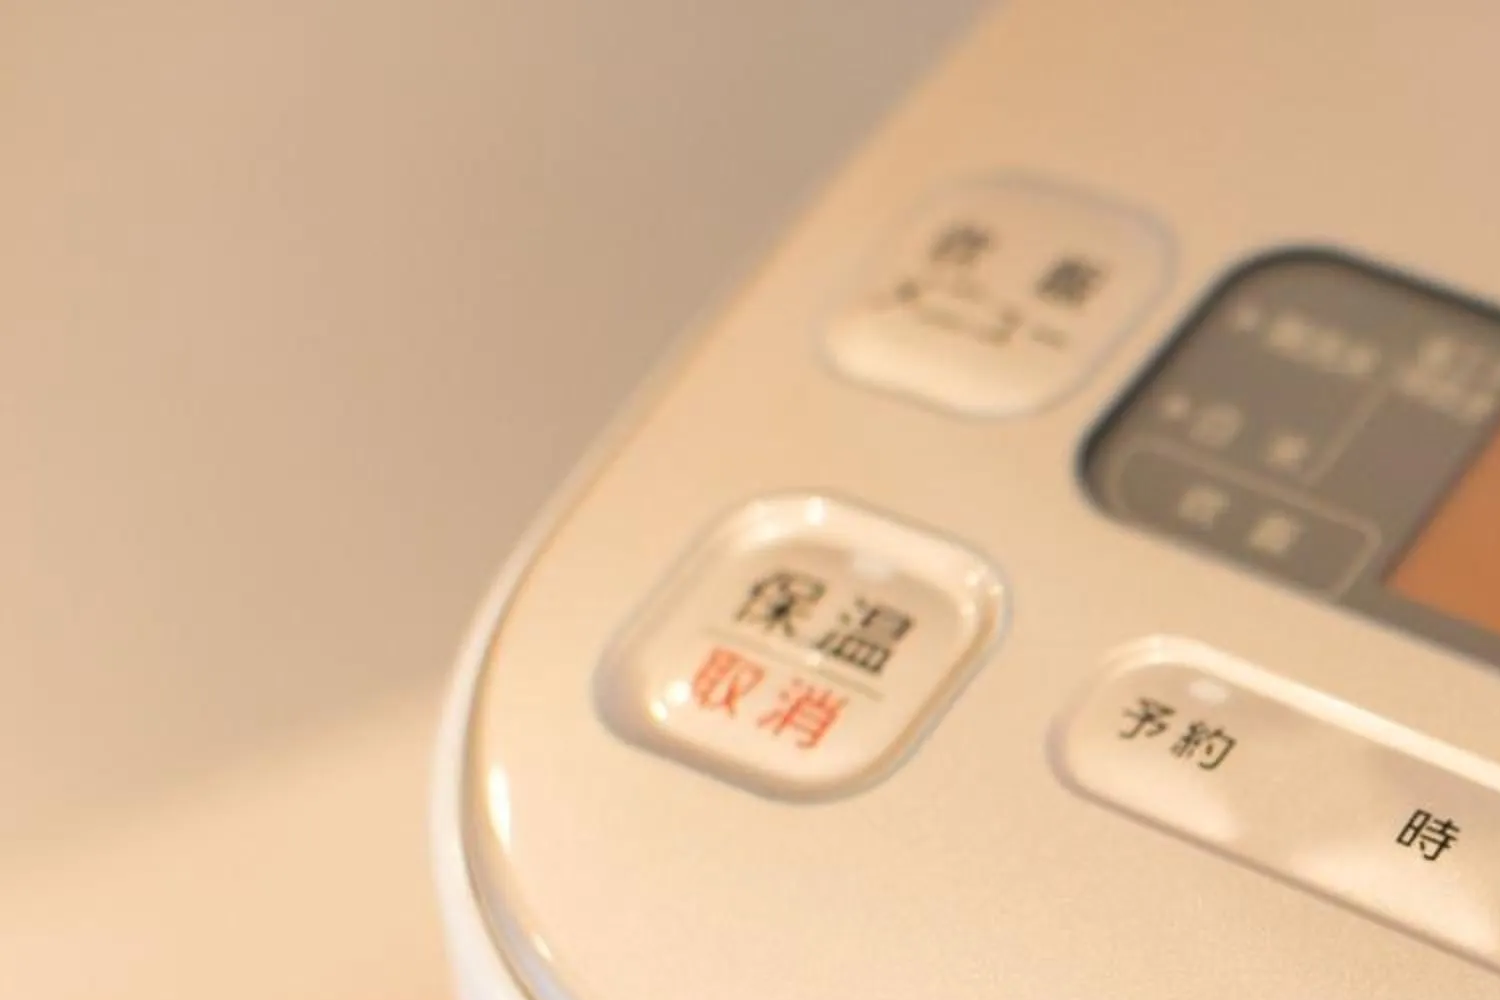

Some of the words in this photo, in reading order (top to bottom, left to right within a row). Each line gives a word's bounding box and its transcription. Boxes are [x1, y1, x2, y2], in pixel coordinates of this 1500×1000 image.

[735, 569, 916, 677] 保温
[692, 646, 849, 749] 取消
[1117, 697, 1237, 772] 予約
[1395, 808, 1461, 862] 時
